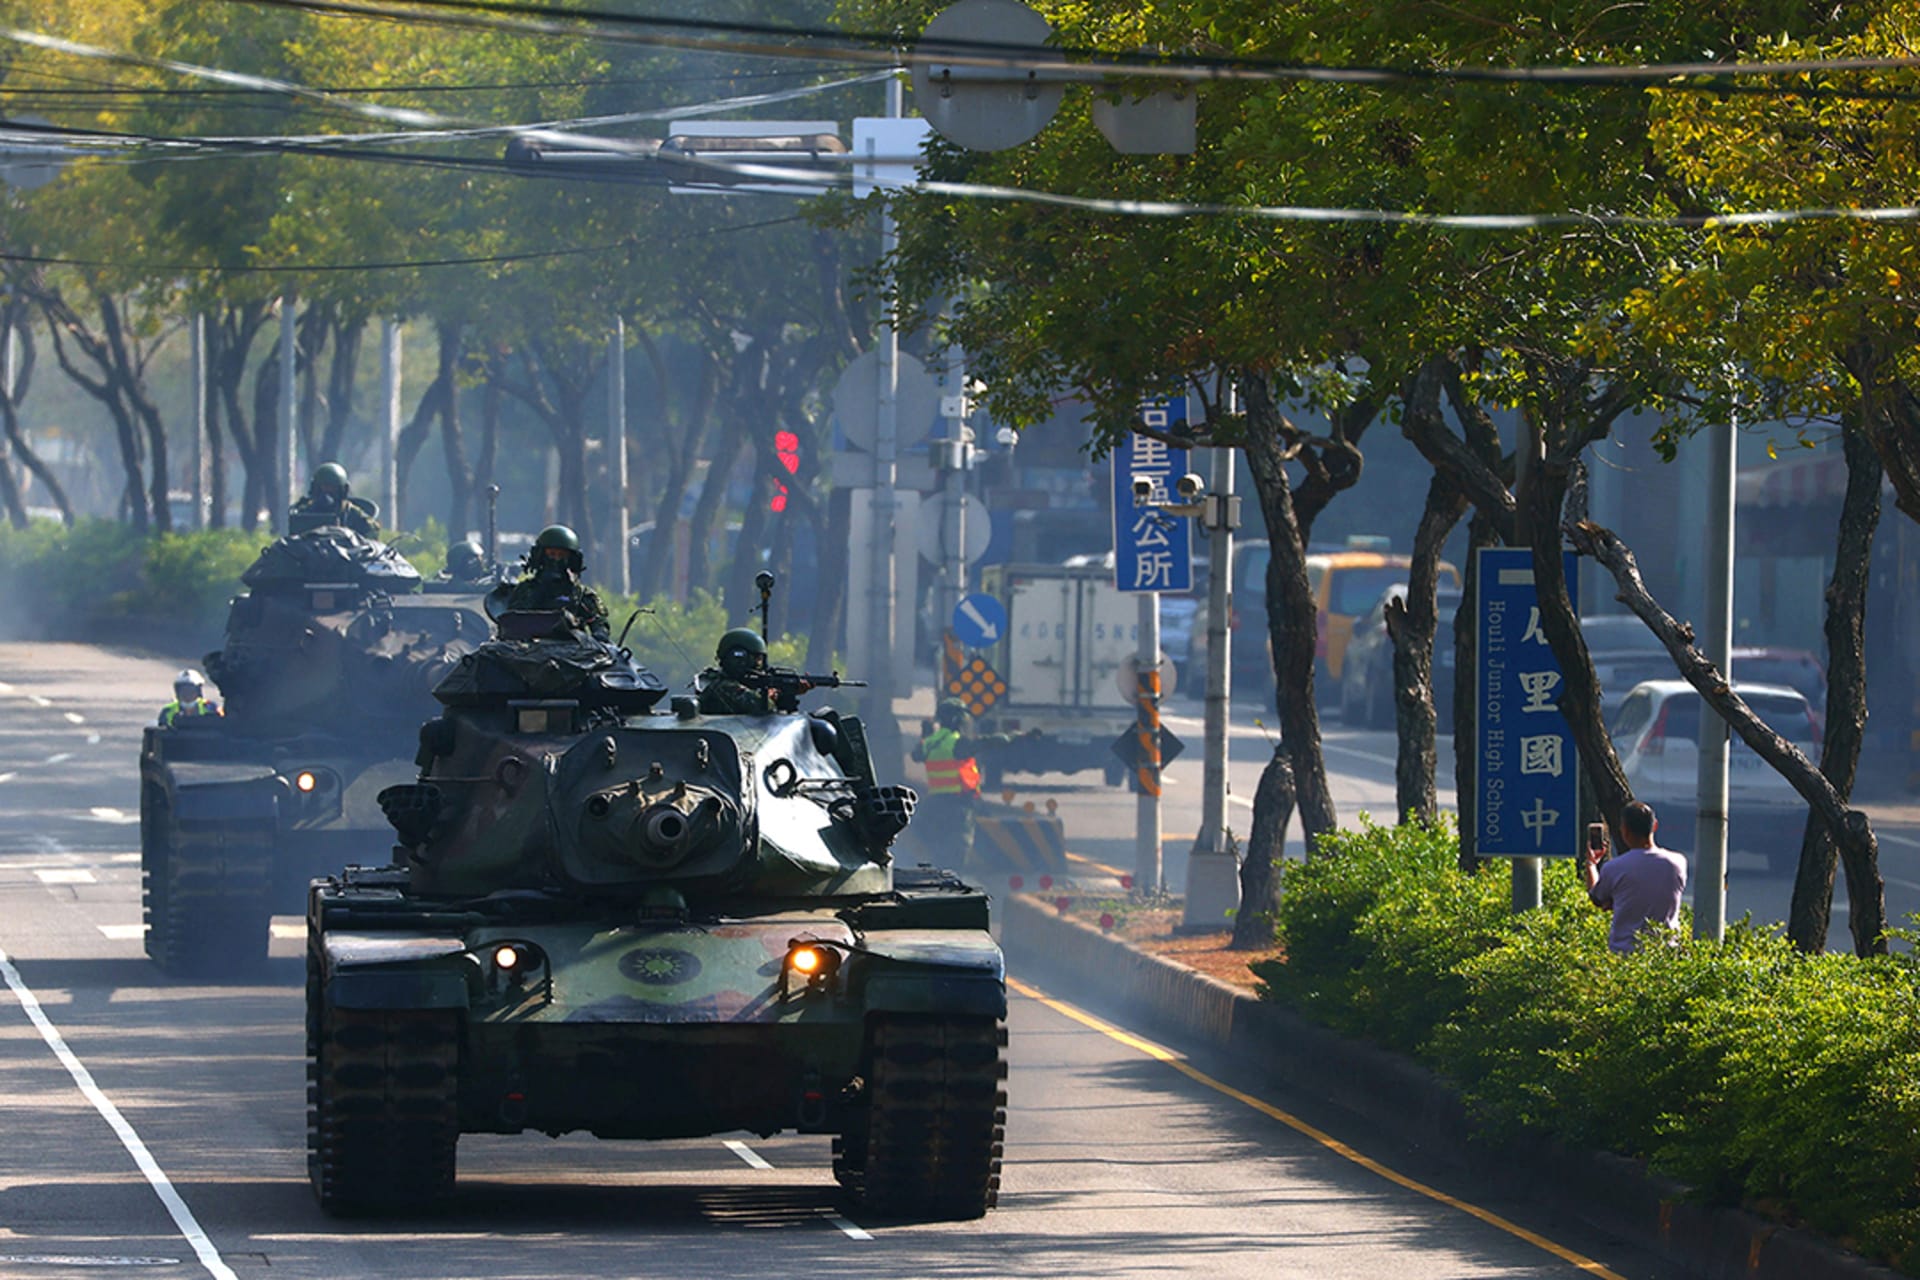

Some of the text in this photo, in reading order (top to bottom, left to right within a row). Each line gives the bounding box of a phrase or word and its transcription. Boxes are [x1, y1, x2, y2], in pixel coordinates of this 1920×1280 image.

[1487, 601, 1505, 652] Houli
[1487, 659, 1505, 723] Junior
[1484, 730, 1504, 771] High
